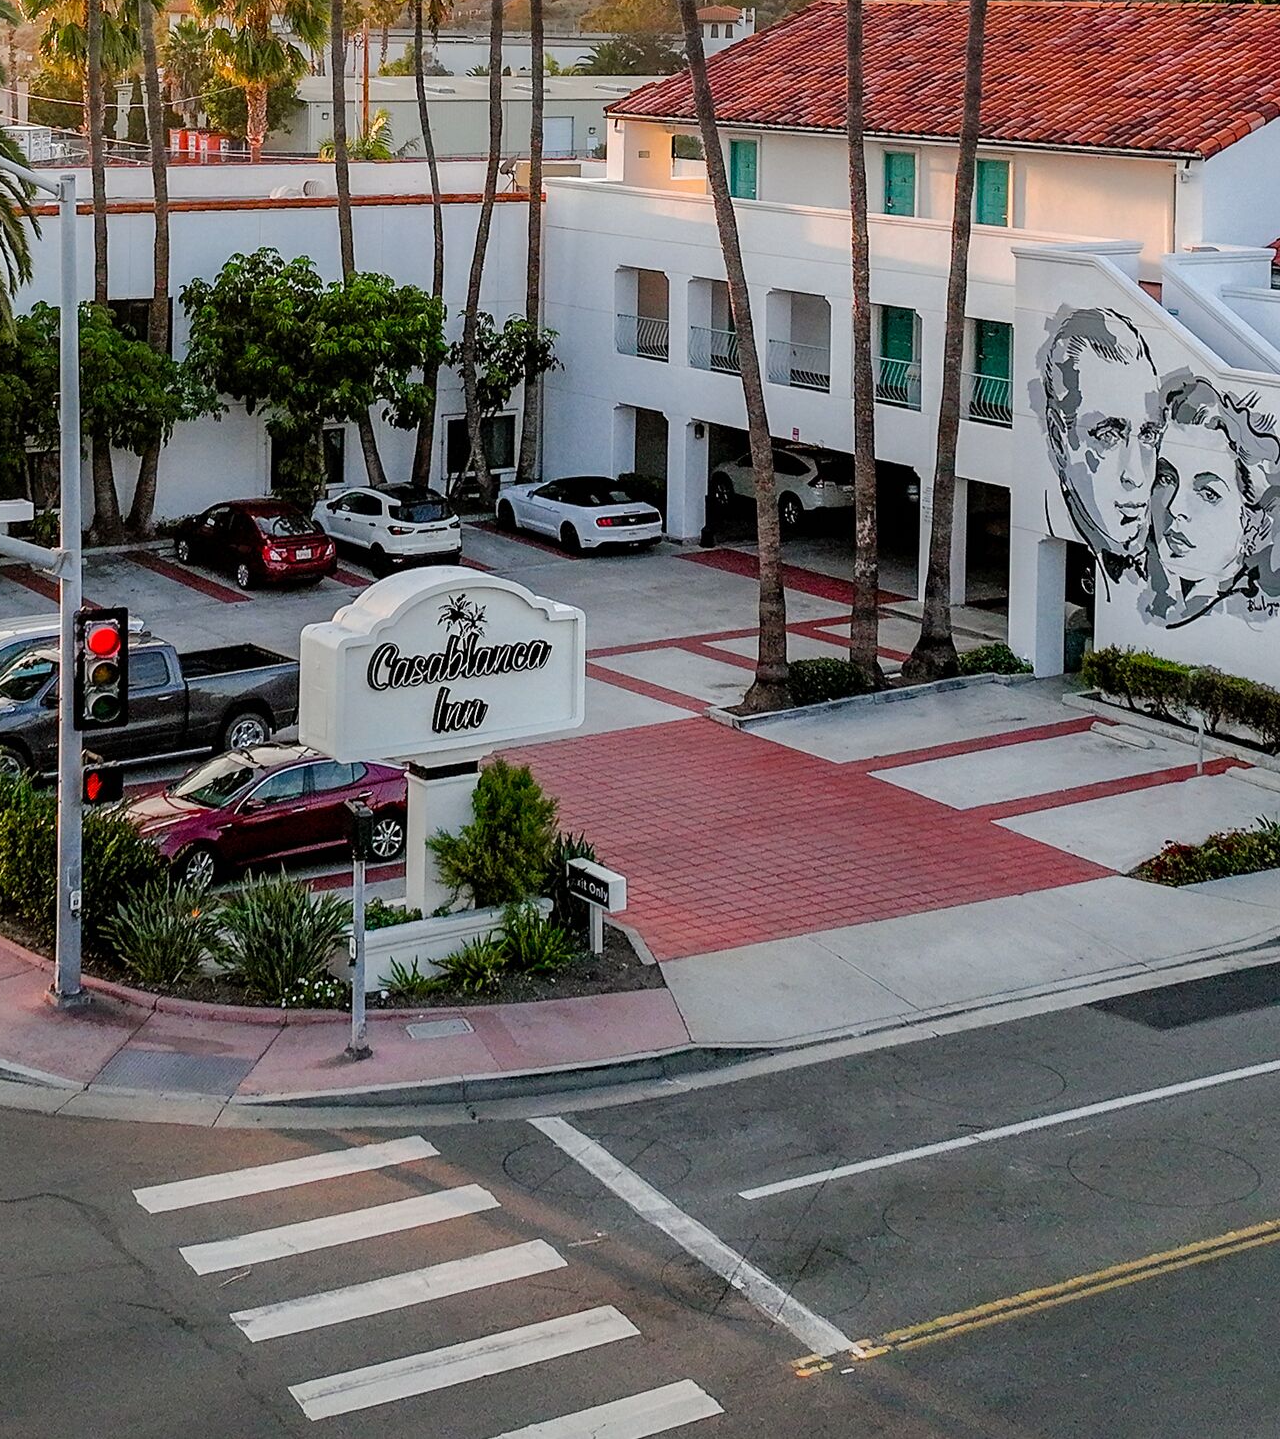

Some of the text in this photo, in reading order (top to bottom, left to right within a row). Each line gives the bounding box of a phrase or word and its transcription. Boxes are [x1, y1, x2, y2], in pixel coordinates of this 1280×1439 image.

[368, 633, 552, 691] Casablanca
[432, 687, 488, 733] Inn
[589, 882, 608, 903] Only
